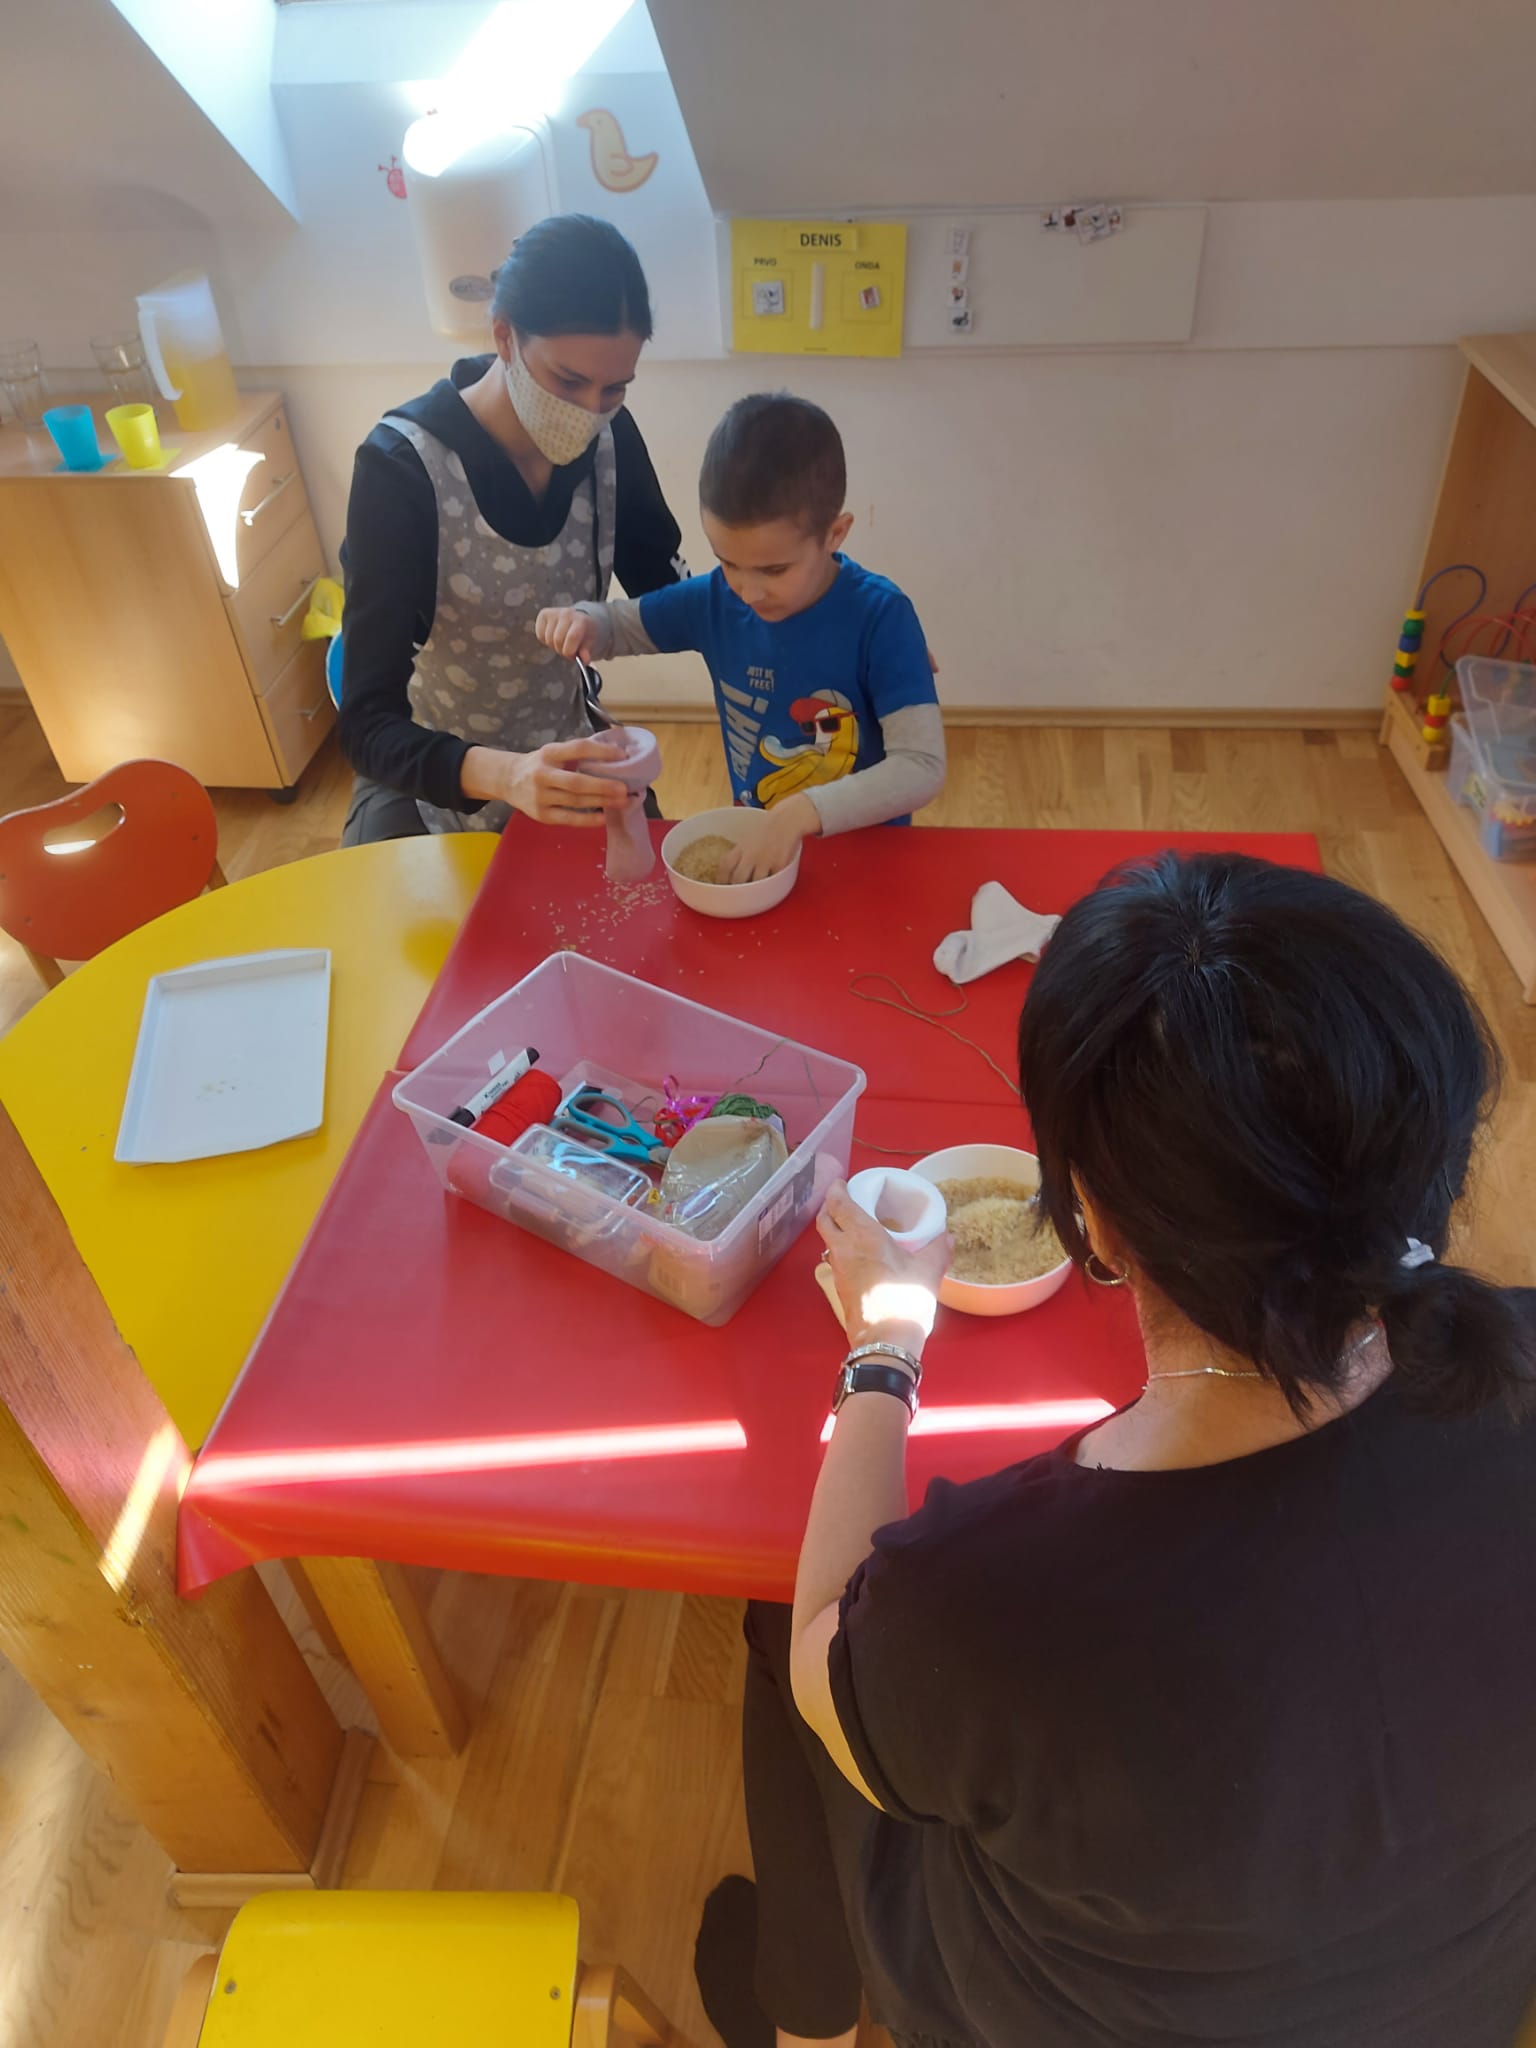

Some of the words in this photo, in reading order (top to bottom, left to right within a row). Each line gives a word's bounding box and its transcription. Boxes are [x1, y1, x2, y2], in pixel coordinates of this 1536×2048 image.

[800, 233, 842, 247] DENIS
[754, 257, 777, 266] PRVO
[855, 261, 880, 270] ONDA
